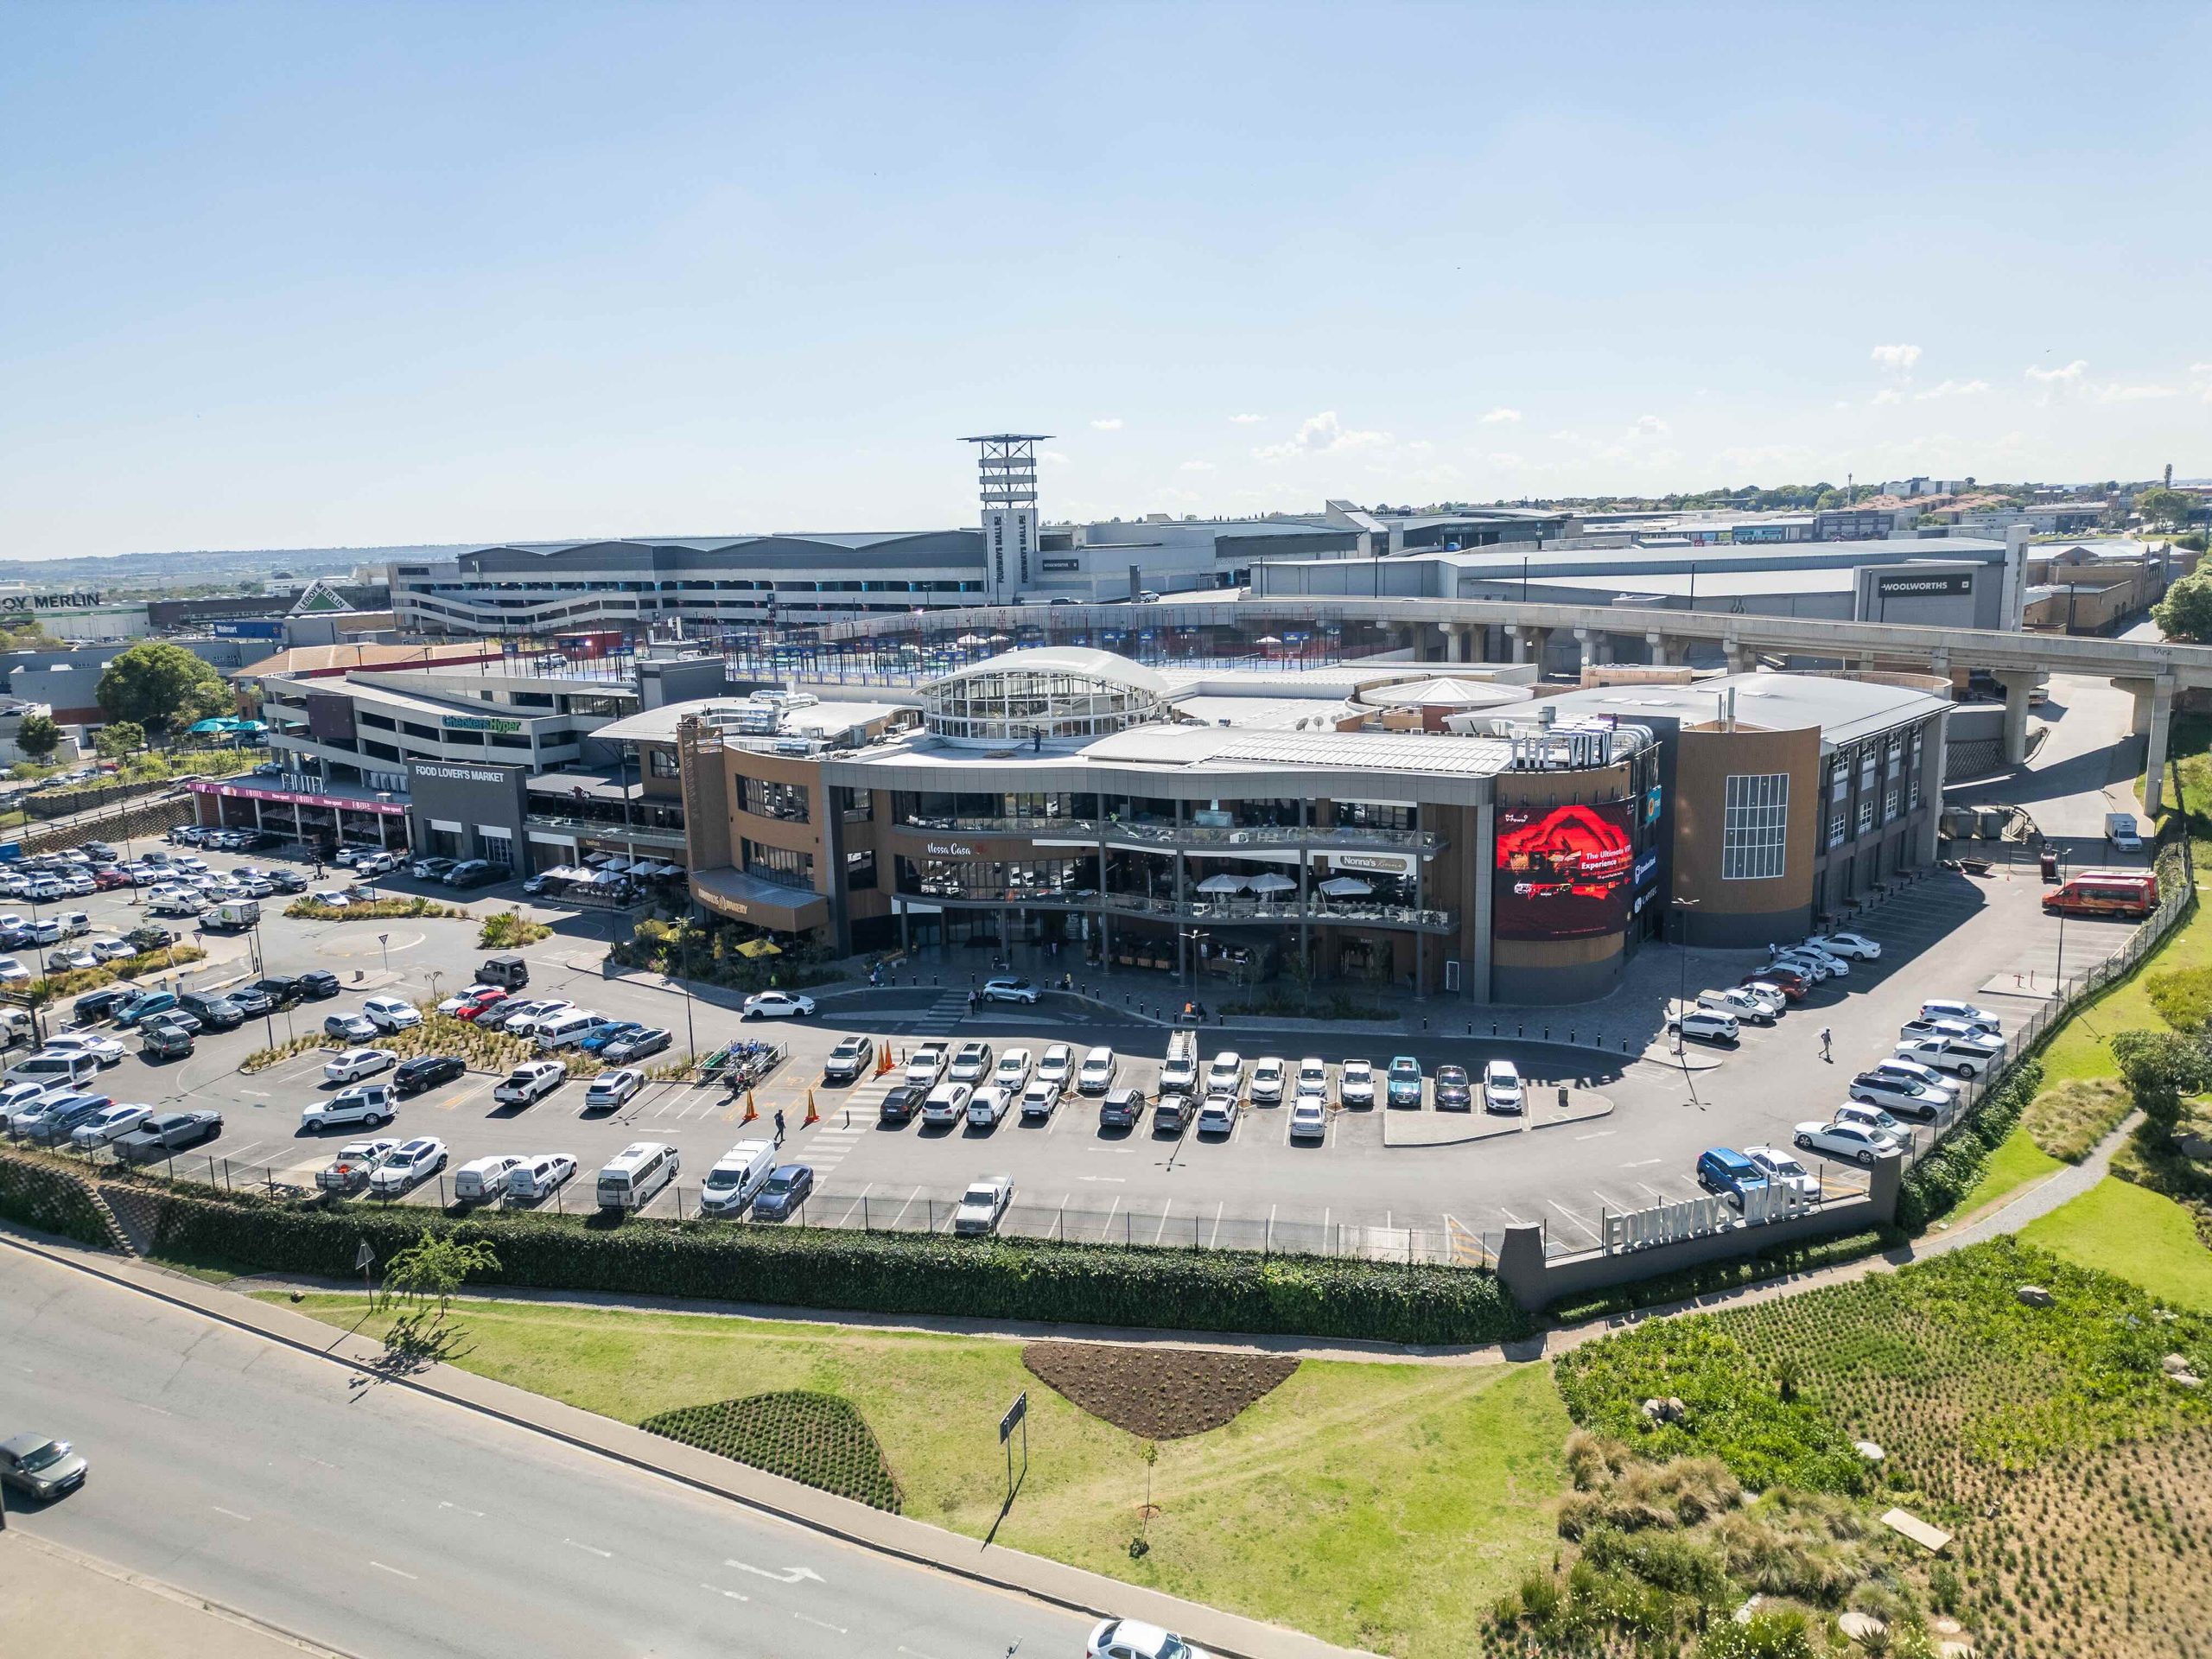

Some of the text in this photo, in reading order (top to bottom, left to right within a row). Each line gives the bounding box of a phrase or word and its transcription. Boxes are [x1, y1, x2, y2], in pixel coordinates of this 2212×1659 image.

[995, 547, 1004, 583] FOURWAYS
[1881, 582, 1948, 591] WOOLWORTHS
[0, 594, 100, 610] OY MERLIN
[299, 582, 346, 610] LEROY MERLIN
[217, 625, 238, 633] Walmart
[442, 715, 520, 733] CheckersHyper
[1511, 733, 1612, 769] THE VIEW
[416, 766, 505, 783] FOOD LOVER'S MARKET
[950, 842, 971, 855] Casa
[1599, 848, 1624, 858] Ultimate
[1344, 856, 1376, 868] Nonna's
[1581, 859, 1618, 871] Experience
[1605, 1179, 1811, 1257] FOURWAYS MALL
